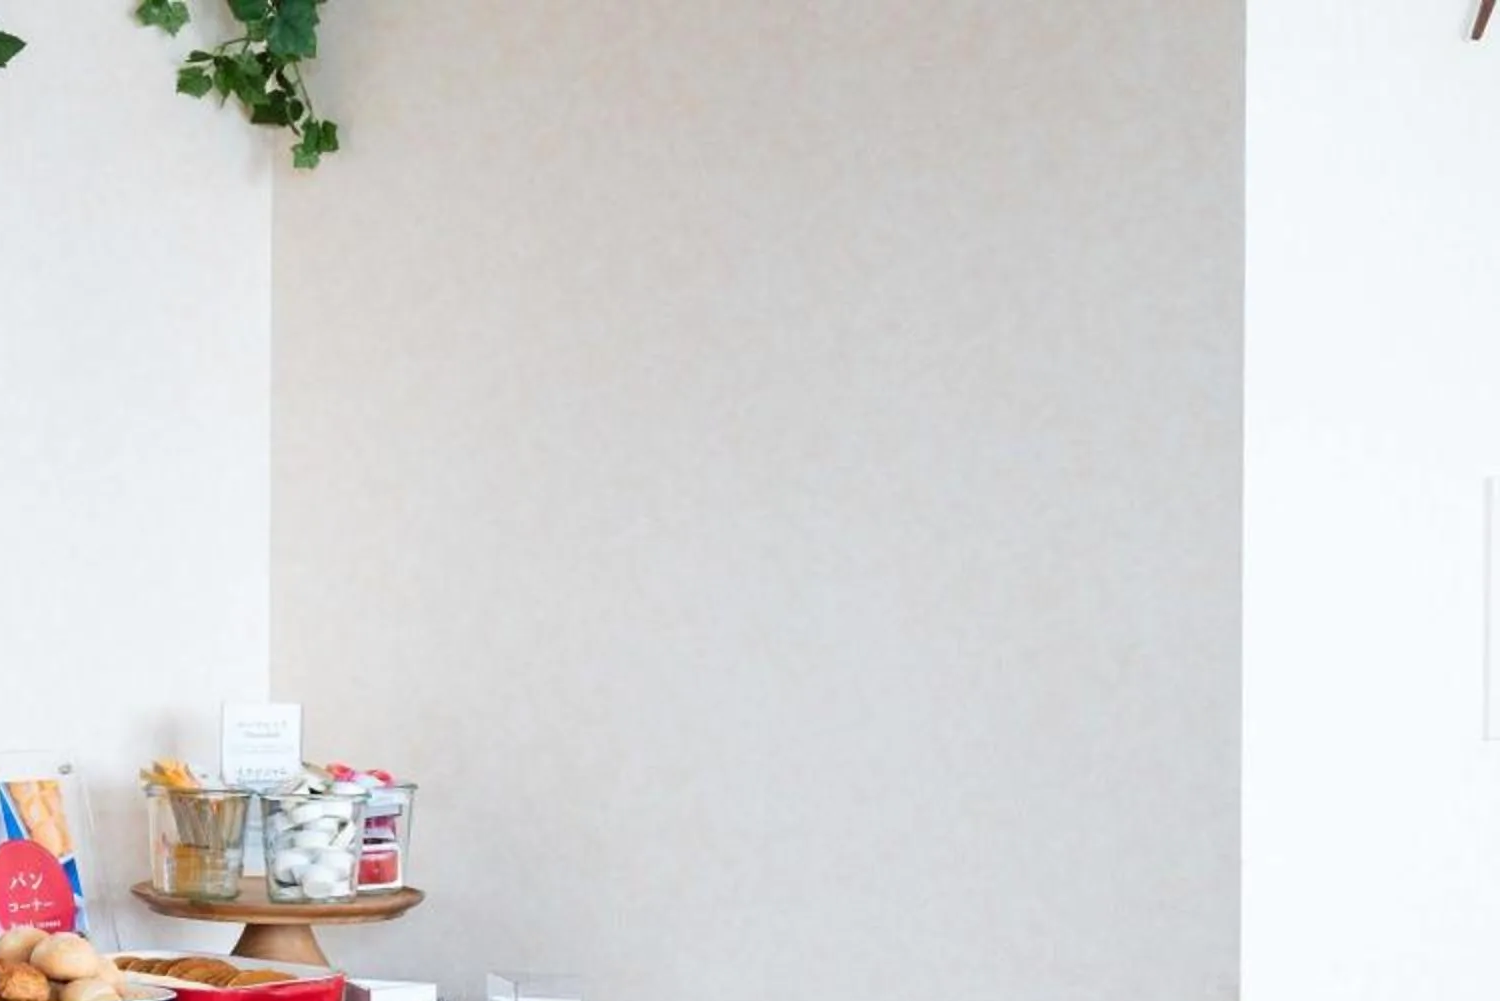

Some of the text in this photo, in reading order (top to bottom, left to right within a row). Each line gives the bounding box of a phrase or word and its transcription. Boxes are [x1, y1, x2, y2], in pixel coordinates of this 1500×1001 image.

[9, 872, 43, 891] パン
[8, 898, 55, 914] コーナー
